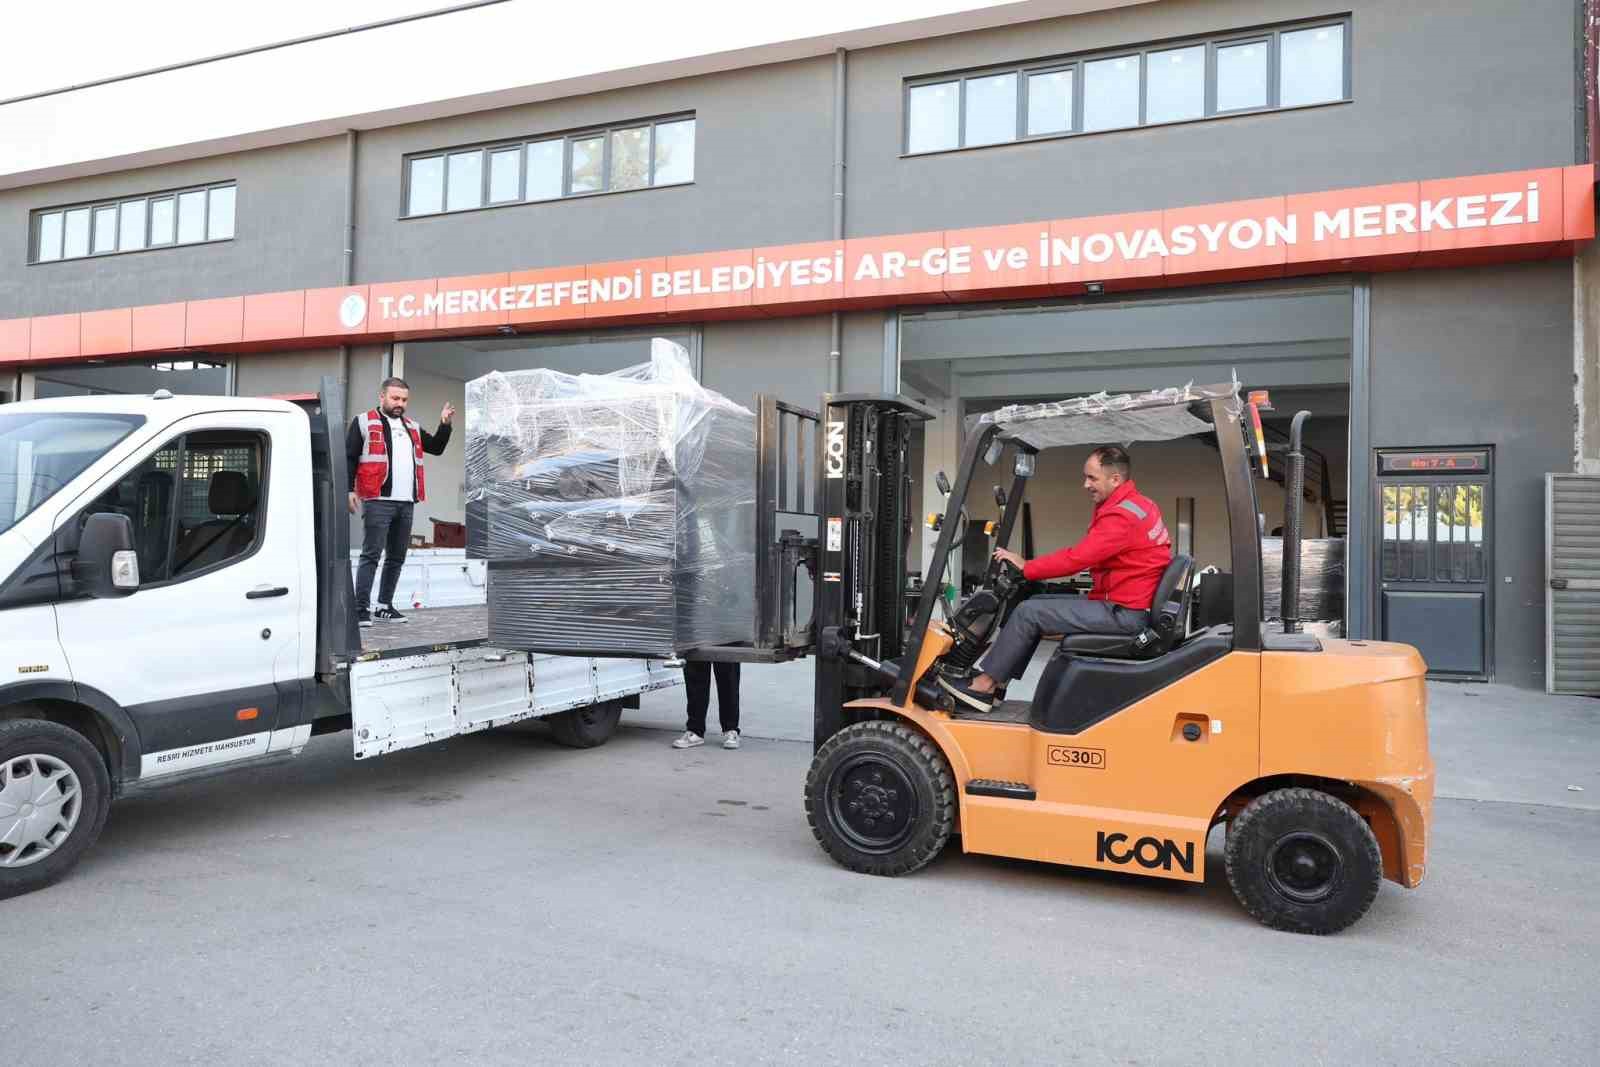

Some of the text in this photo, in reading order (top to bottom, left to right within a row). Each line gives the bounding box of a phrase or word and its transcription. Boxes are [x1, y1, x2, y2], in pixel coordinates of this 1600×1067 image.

[651, 249, 844, 299] BELEDİYESİ
[854, 245, 971, 281] AR-GE
[984, 247, 1028, 271] ve
[1040, 213, 1298, 268] İNOVASYON
[1313, 181, 1540, 241] MERKEZİ
[827, 421, 844, 478] ICON
[214, 738, 256, 751] MAHSUSTUR
[1050, 749, 1103, 766] CS30D
[1096, 831, 1194, 874] ICON
